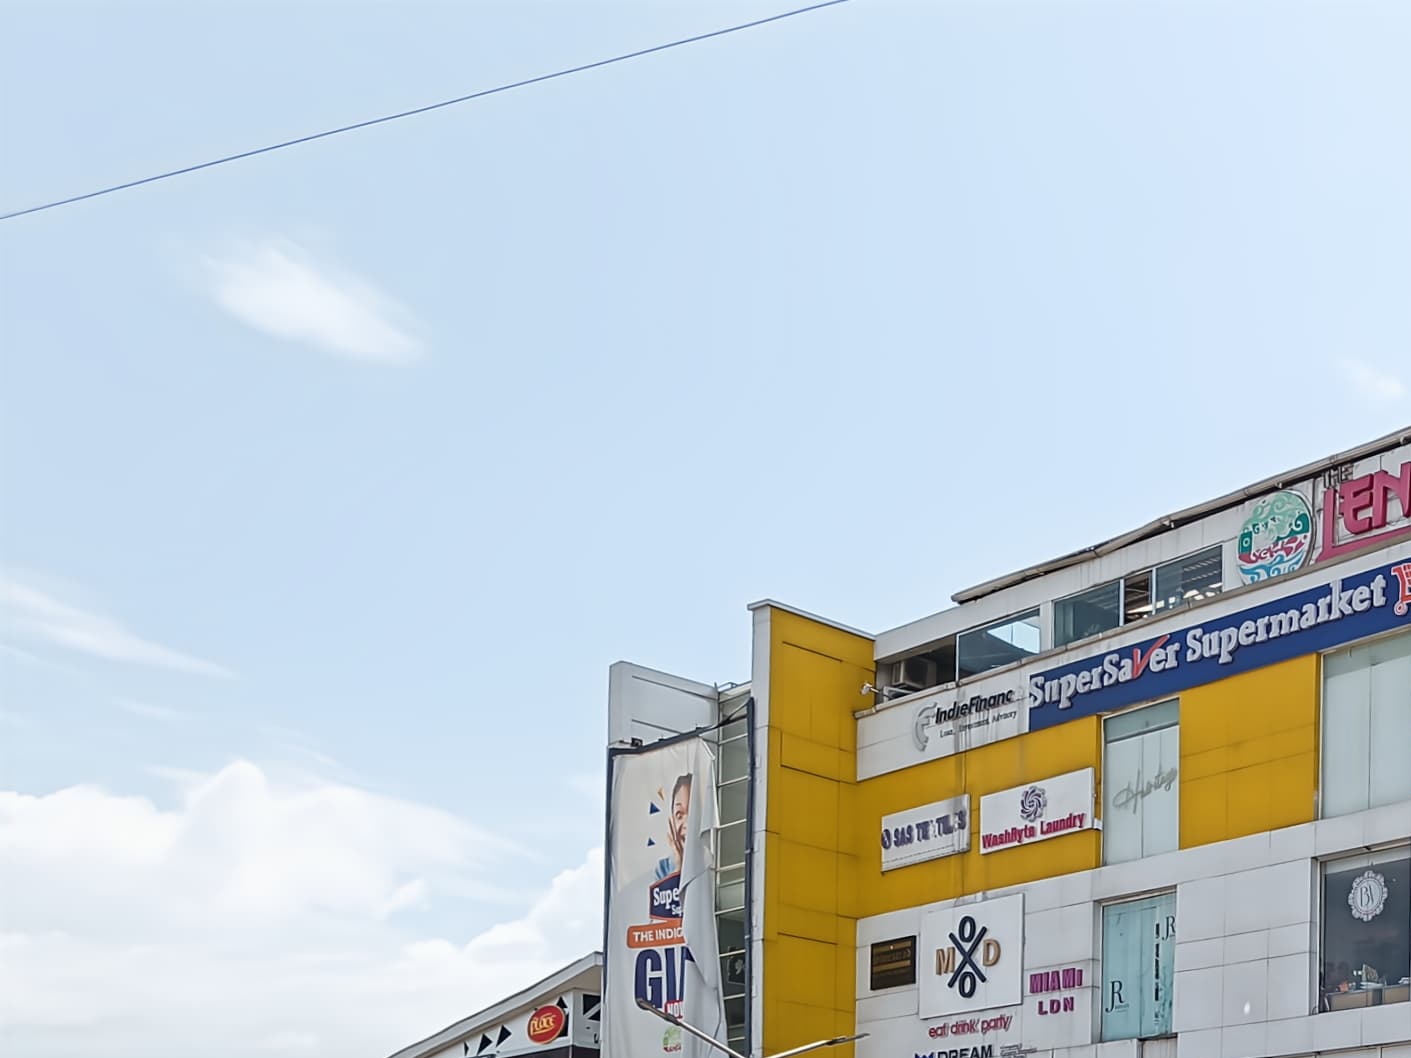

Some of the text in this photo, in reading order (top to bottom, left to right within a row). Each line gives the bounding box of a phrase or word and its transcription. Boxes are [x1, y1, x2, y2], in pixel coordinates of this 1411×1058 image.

[1029, 573, 1387, 708] SuperSaver Supermarket
[1040, 812, 1087, 836] Laundry
[633, 930, 654, 942] THE
[1029, 967, 1084, 994] MIAMI
[1037, 997, 1075, 1015] LDN
